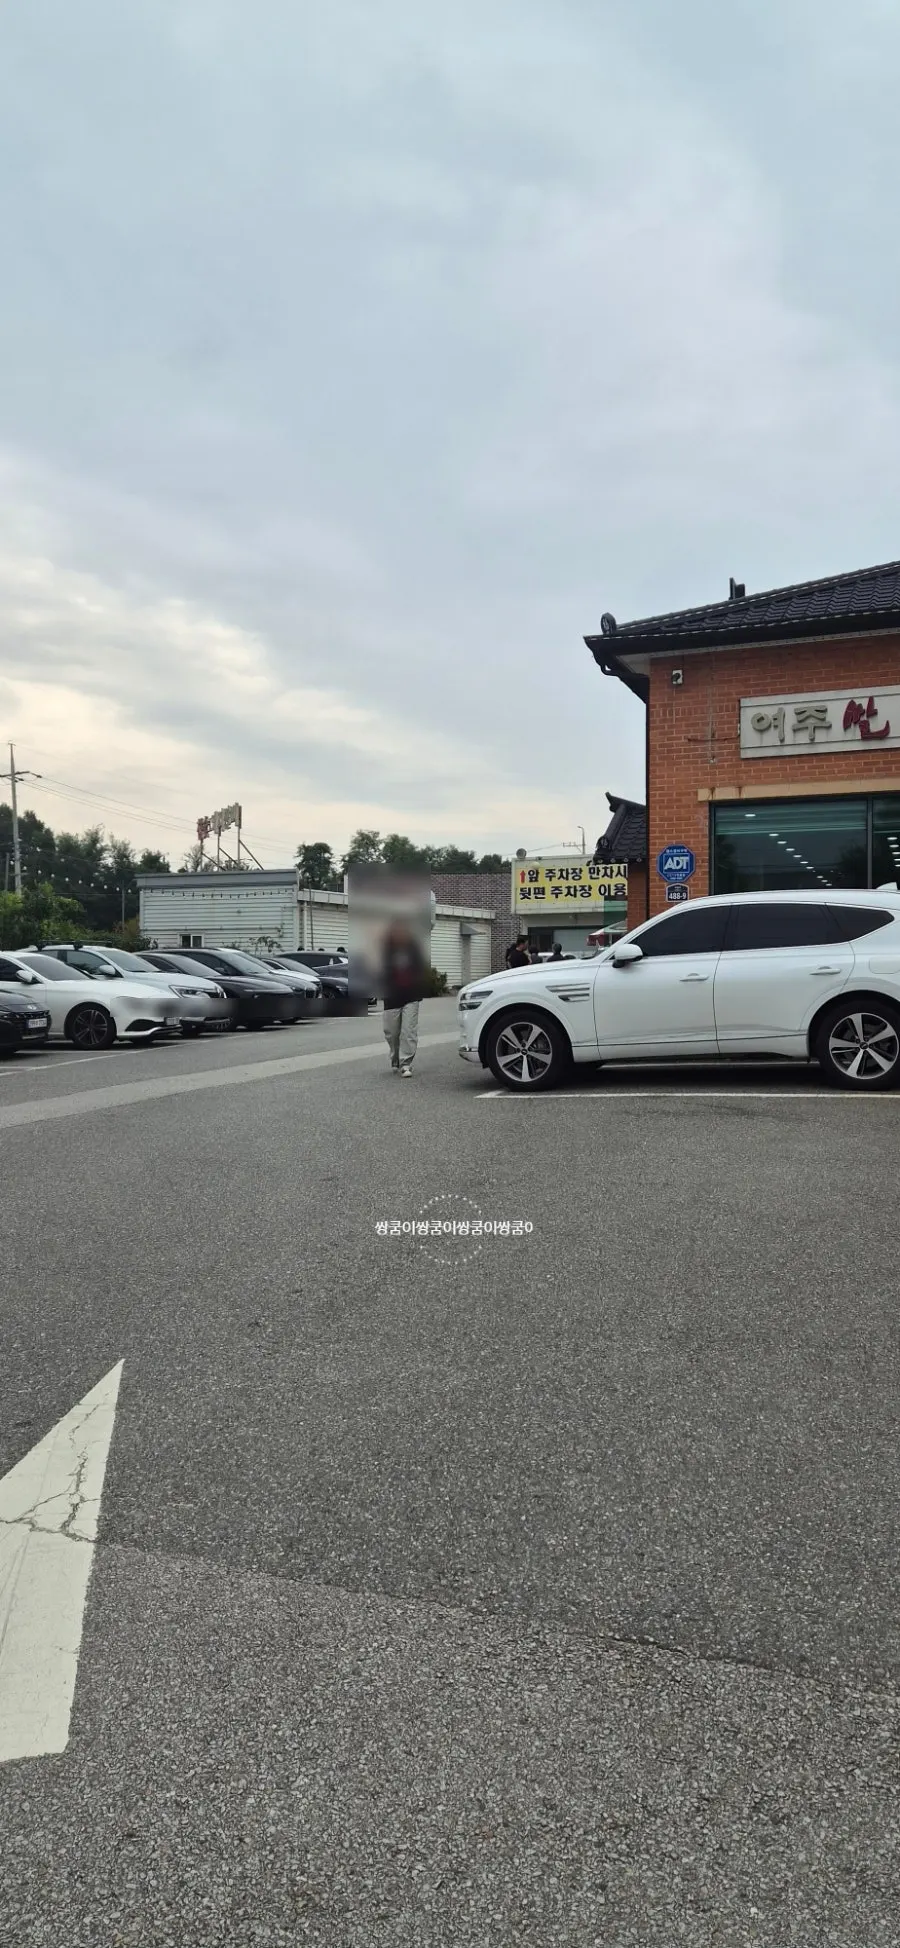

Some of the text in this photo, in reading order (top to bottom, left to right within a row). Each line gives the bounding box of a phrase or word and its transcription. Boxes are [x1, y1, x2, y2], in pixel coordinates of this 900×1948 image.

[663, 856, 690, 870] ADT
[527, 865, 627, 883] 앞 주차장 만차시
[519, 883, 627, 900] 뒷편 주차장 이용
[668, 892, 687, 900] 488-9
